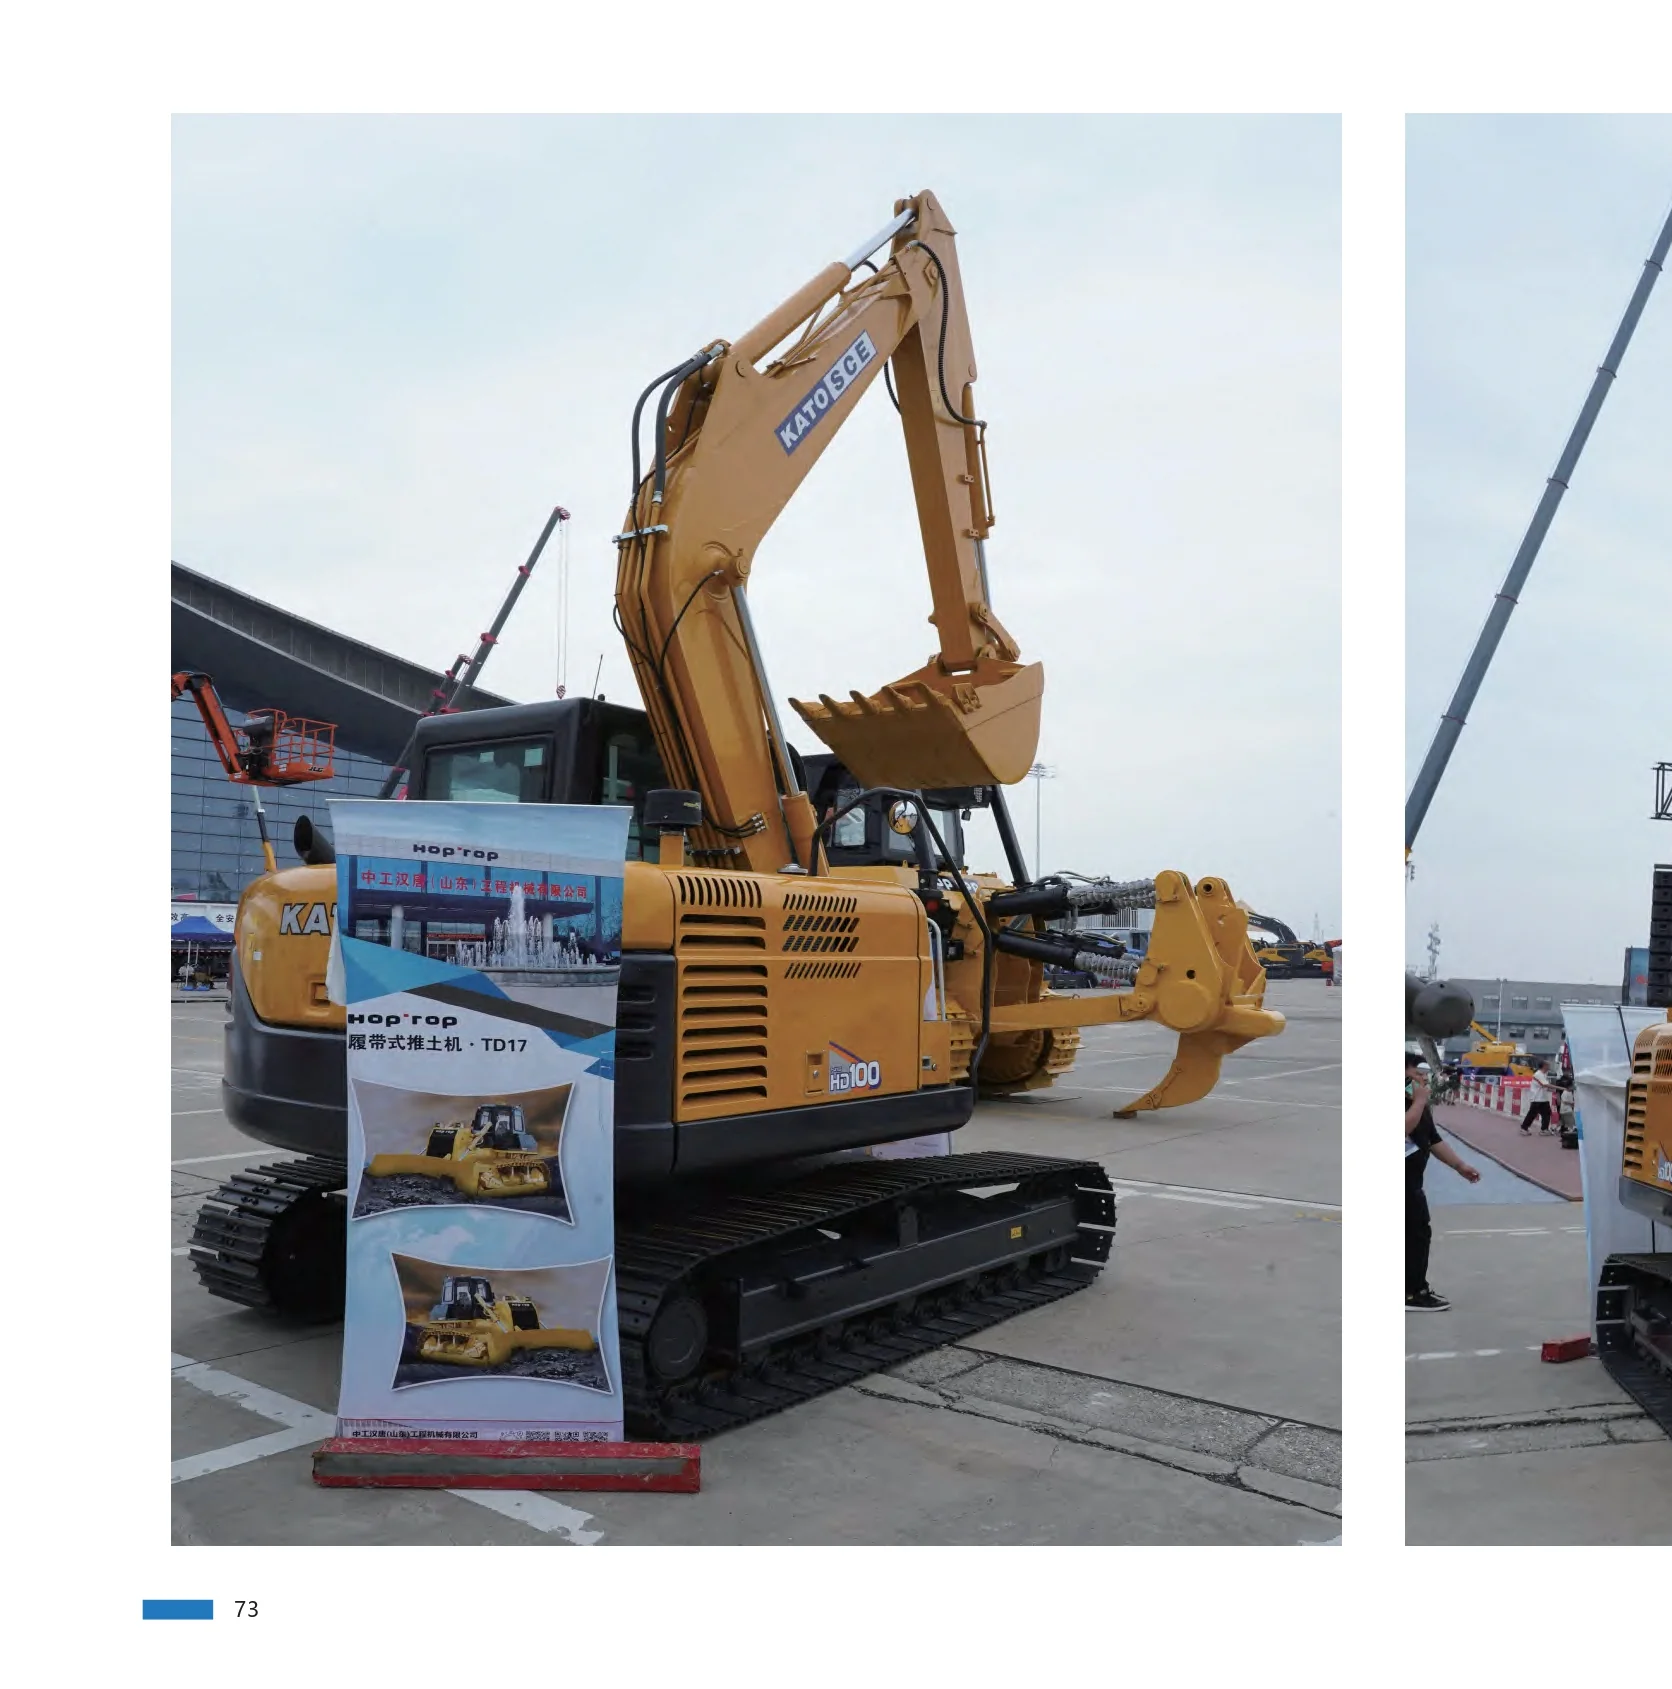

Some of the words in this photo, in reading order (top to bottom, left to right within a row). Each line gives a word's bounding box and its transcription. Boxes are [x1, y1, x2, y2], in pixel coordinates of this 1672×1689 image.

[779, 388, 829, 448] KATO
[830, 339, 870, 391] SCE
[279, 902, 337, 936] KA
